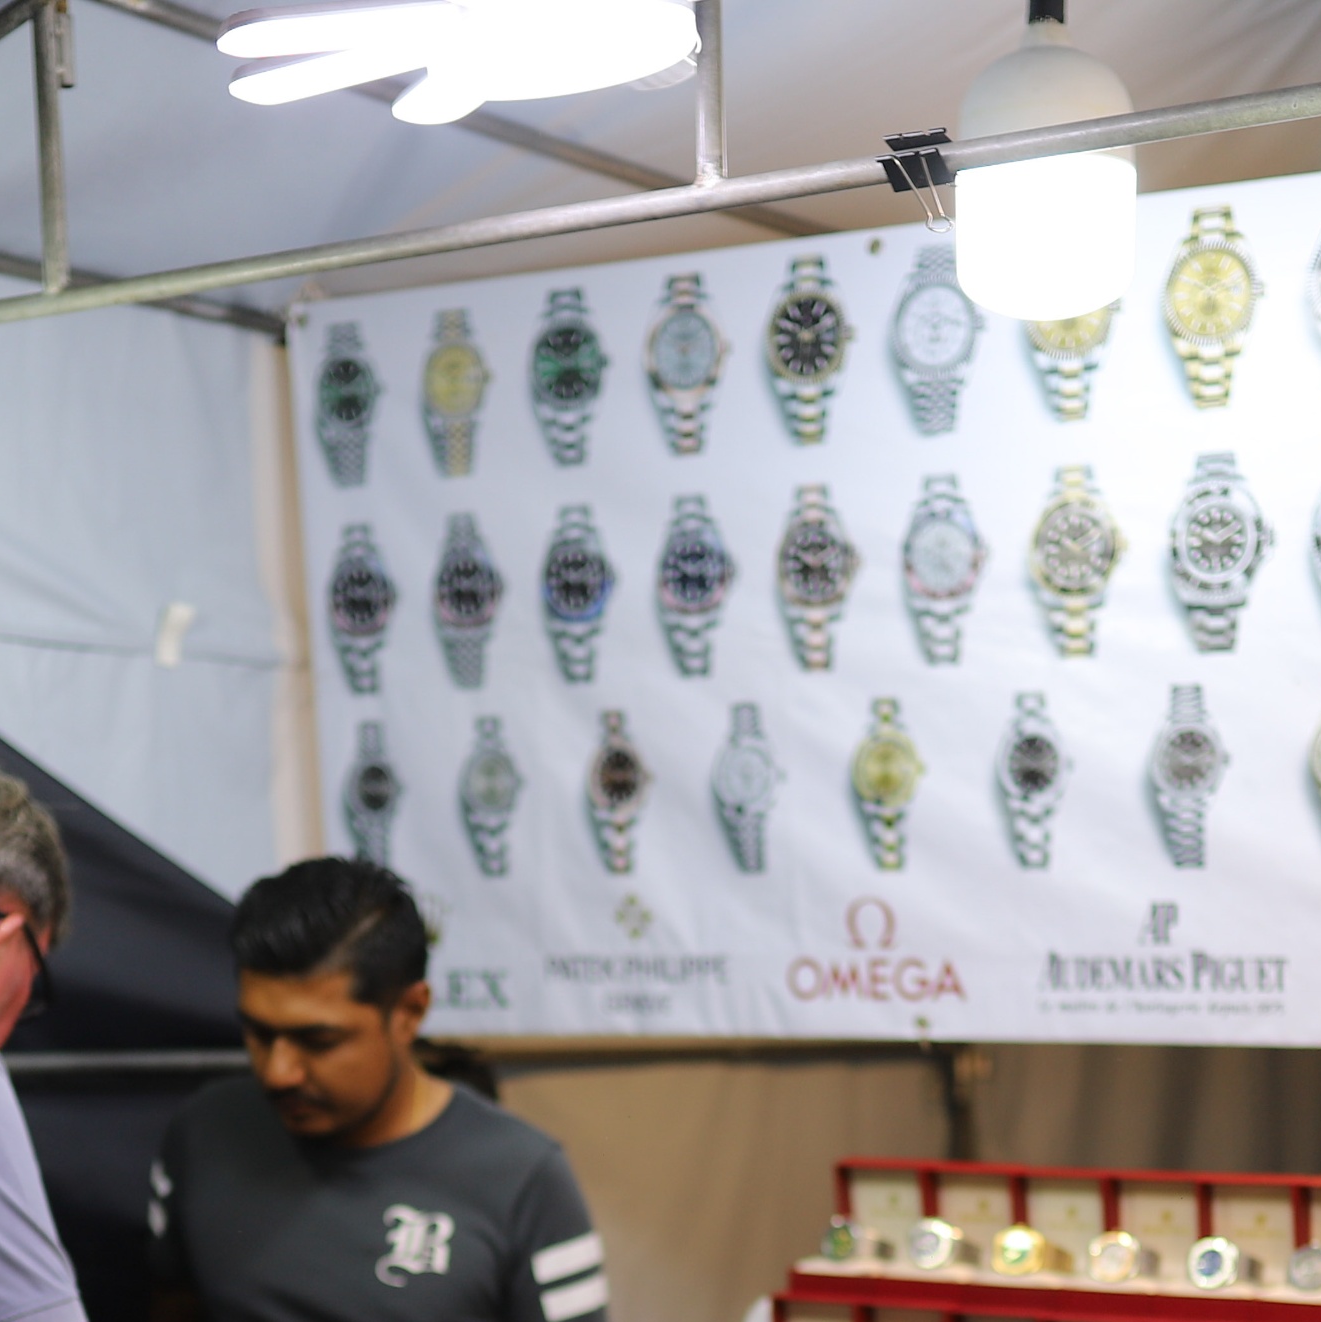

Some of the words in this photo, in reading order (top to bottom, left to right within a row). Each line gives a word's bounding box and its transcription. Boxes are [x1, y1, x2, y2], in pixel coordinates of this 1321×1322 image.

[785, 956, 968, 1002] OMEGA
[1040, 949, 1185, 991] AUDEMARS
[1189, 948, 1289, 992] PIGUET
